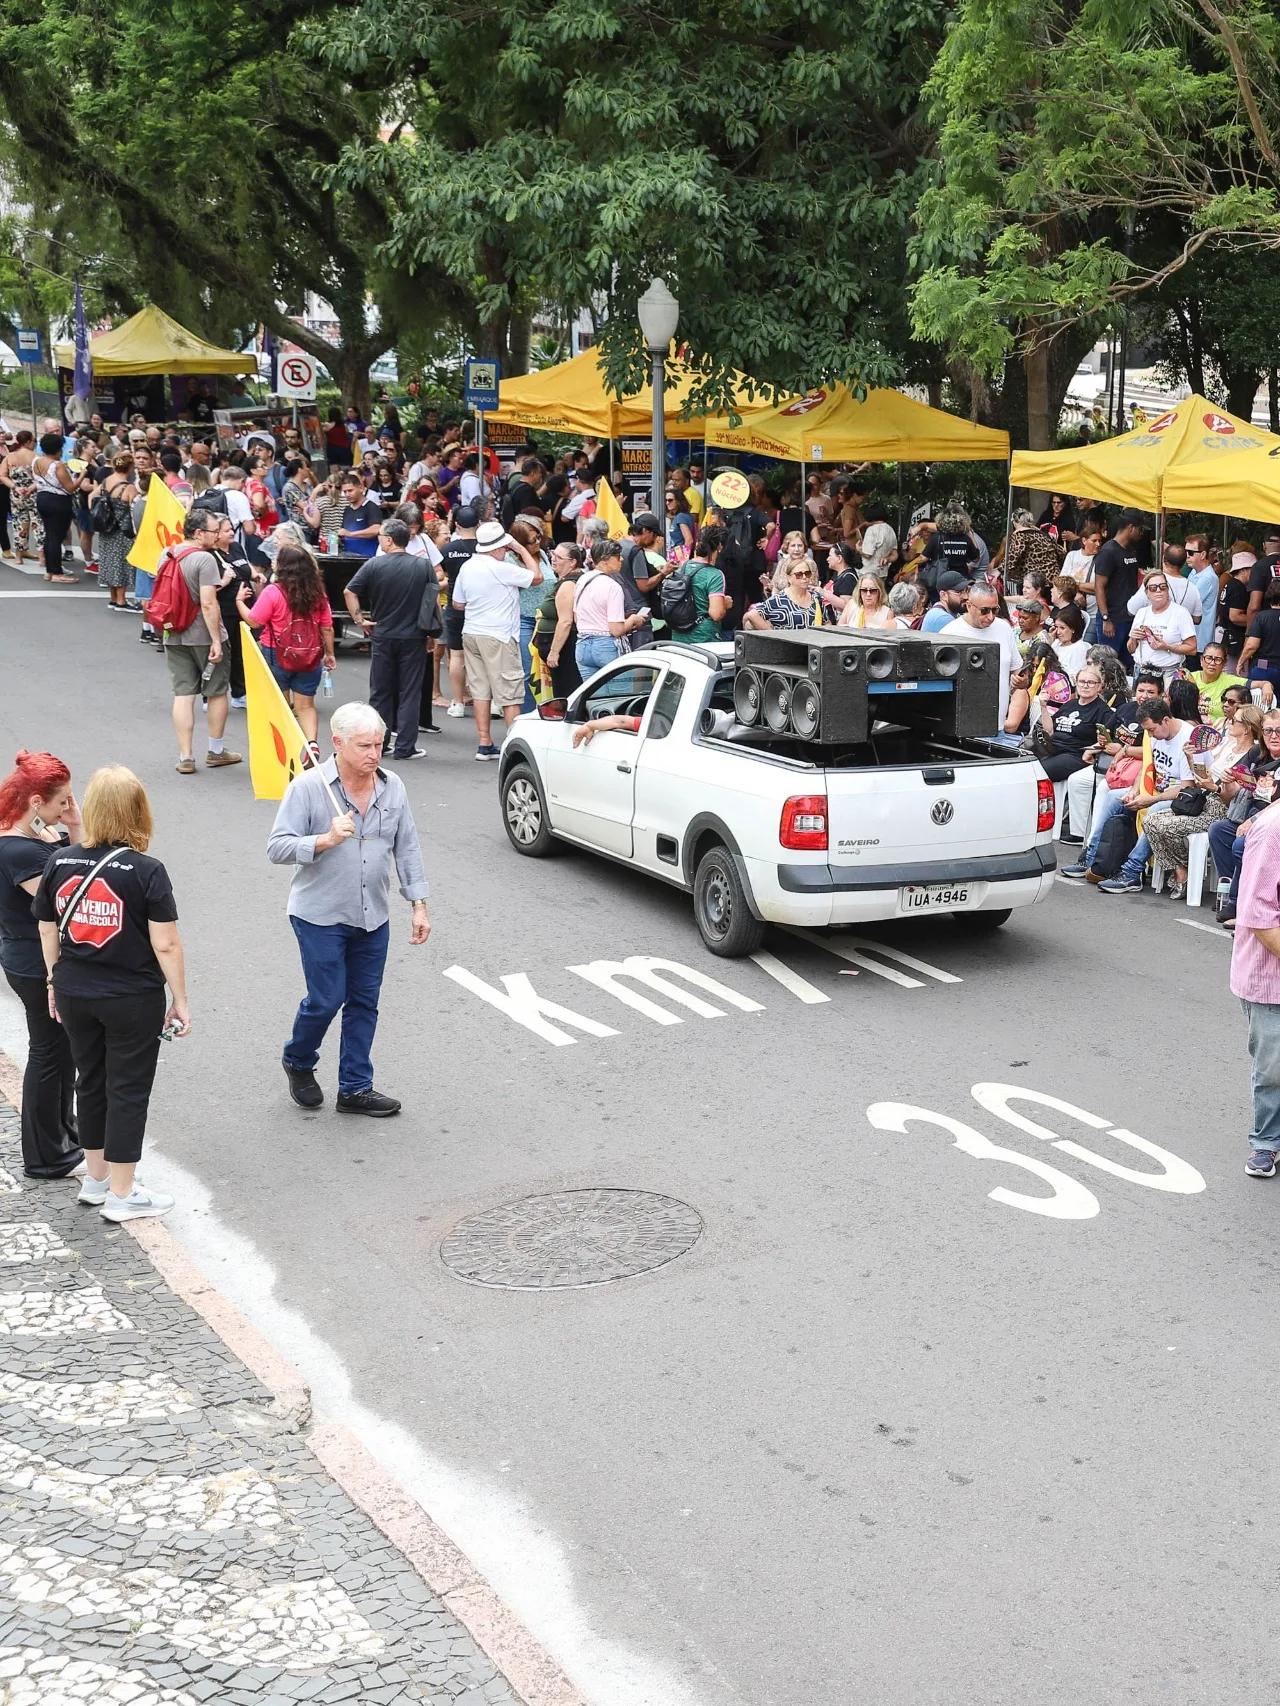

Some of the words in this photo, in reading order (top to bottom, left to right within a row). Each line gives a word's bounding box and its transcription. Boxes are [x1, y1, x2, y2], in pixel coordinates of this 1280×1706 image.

[622, 450, 652, 463] MARC
[716, 488, 742, 503] Núcleo
[837, 839, 880, 847] SAVEIRO
[81, 899, 118, 917] VENDA
[89, 914, 119, 927] ESCOLA
[866, 1081, 1207, 1220] 30
